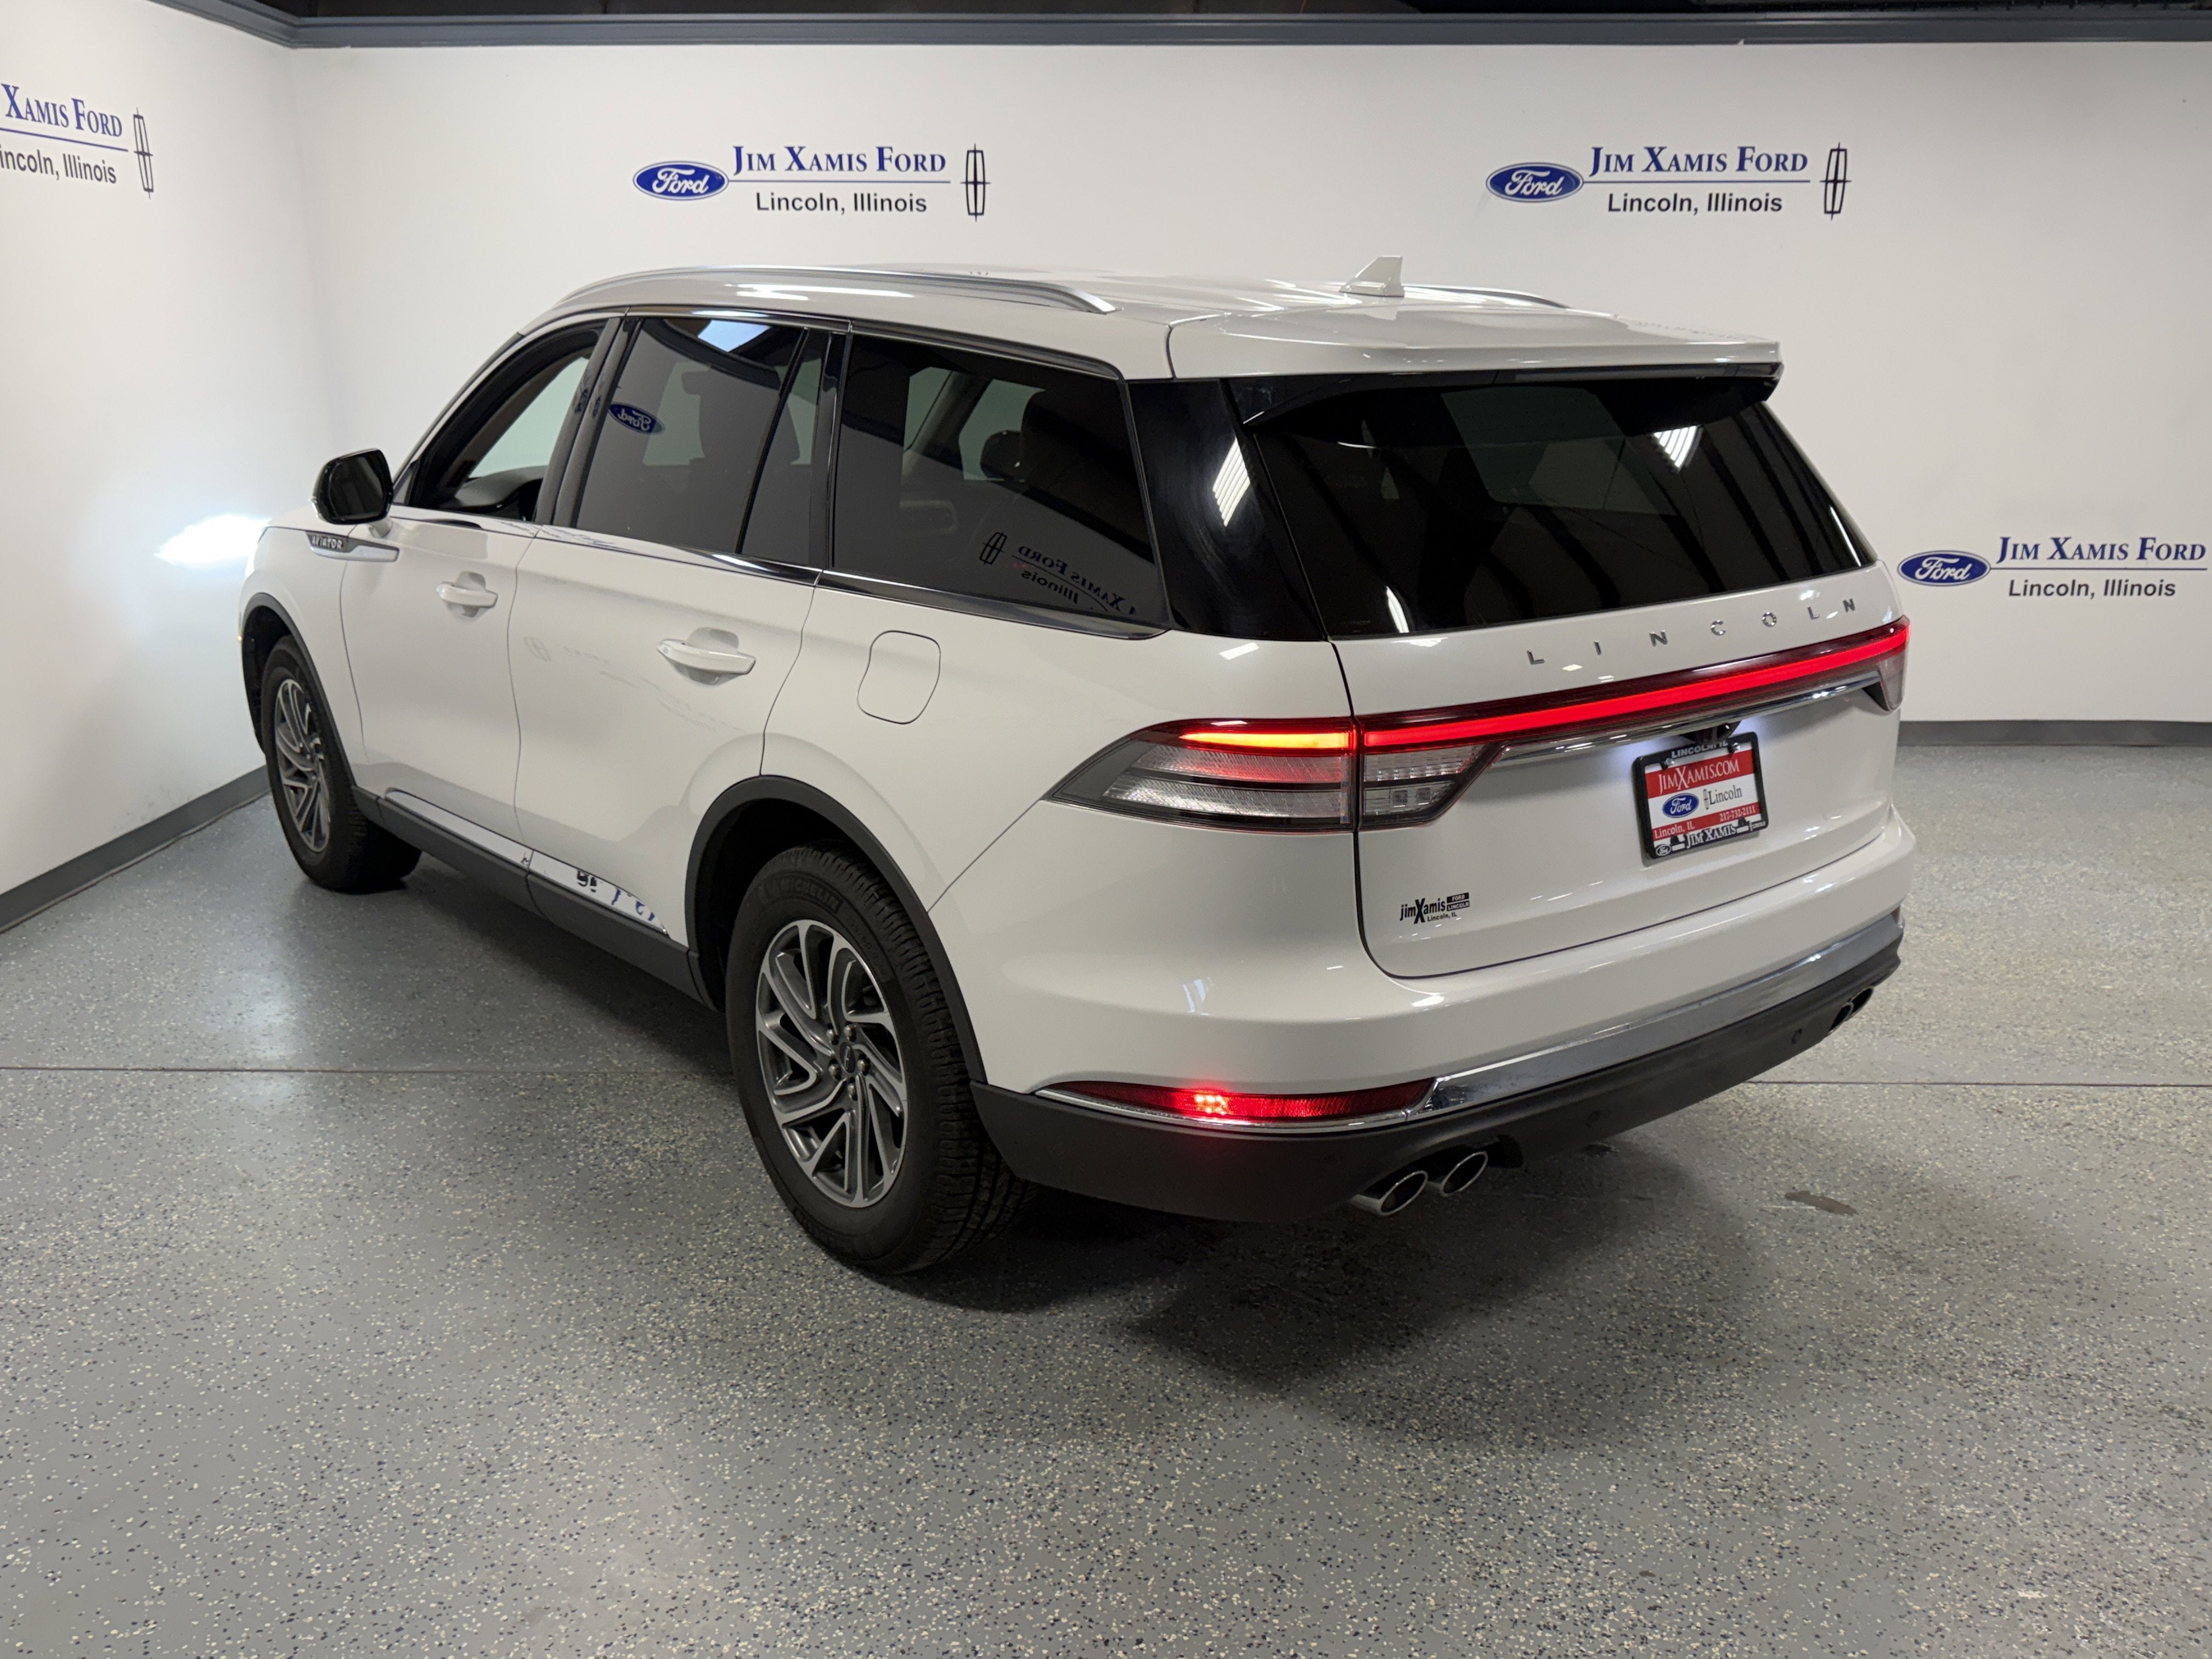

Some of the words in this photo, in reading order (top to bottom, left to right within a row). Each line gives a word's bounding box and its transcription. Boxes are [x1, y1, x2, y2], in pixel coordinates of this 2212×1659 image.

[1, 84, 69, 127] XAMIS
[71, 98, 122, 137] FORD
[0, 144, 59, 180] incoln,
[63, 154, 116, 183] Illinois
[733, 146, 775, 176] JIM
[785, 146, 867, 172] XAMIS
[877, 146, 945, 172] FORD
[1589, 146, 1634, 177] JIM
[1642, 146, 1727, 172] XAMIS
[1736, 146, 1808, 172] FORD
[652, 168, 710, 194] Ford
[1504, 170, 1564, 196] Ford
[756, 193, 845, 215] Lincoln,
[854, 193, 927, 212] Illinois
[1608, 193, 1698, 215] Lincoln,
[1708, 193, 1782, 212] Illinois
[312, 535, 342, 549] AVIATOR
[1996, 537, 2040, 564] JIM
[2047, 537, 2129, 561] XAMIS
[2136, 537, 2206, 561] FORD
[1915, 556, 1972, 580] Ford
[2008, 579, 2095, 600] Lincoln,
[2103, 579, 2176, 597] Illinois
[1526, 598, 1855, 664] LINCOLN
[1671, 797, 1691, 814] Ford
[1708, 785, 1742, 805] Lincoln
[1719, 805, 1756, 822] 217-732-2111
[1654, 824, 1686, 839] Lincoln,
[1687, 821, 1696, 830] IL
[1686, 832, 1703, 849] JIM
[1705, 823, 1736, 842] XAMIS
[1427, 913, 1450, 922] Lincoln,
[1448, 902, 1469, 911] LINCOLN
